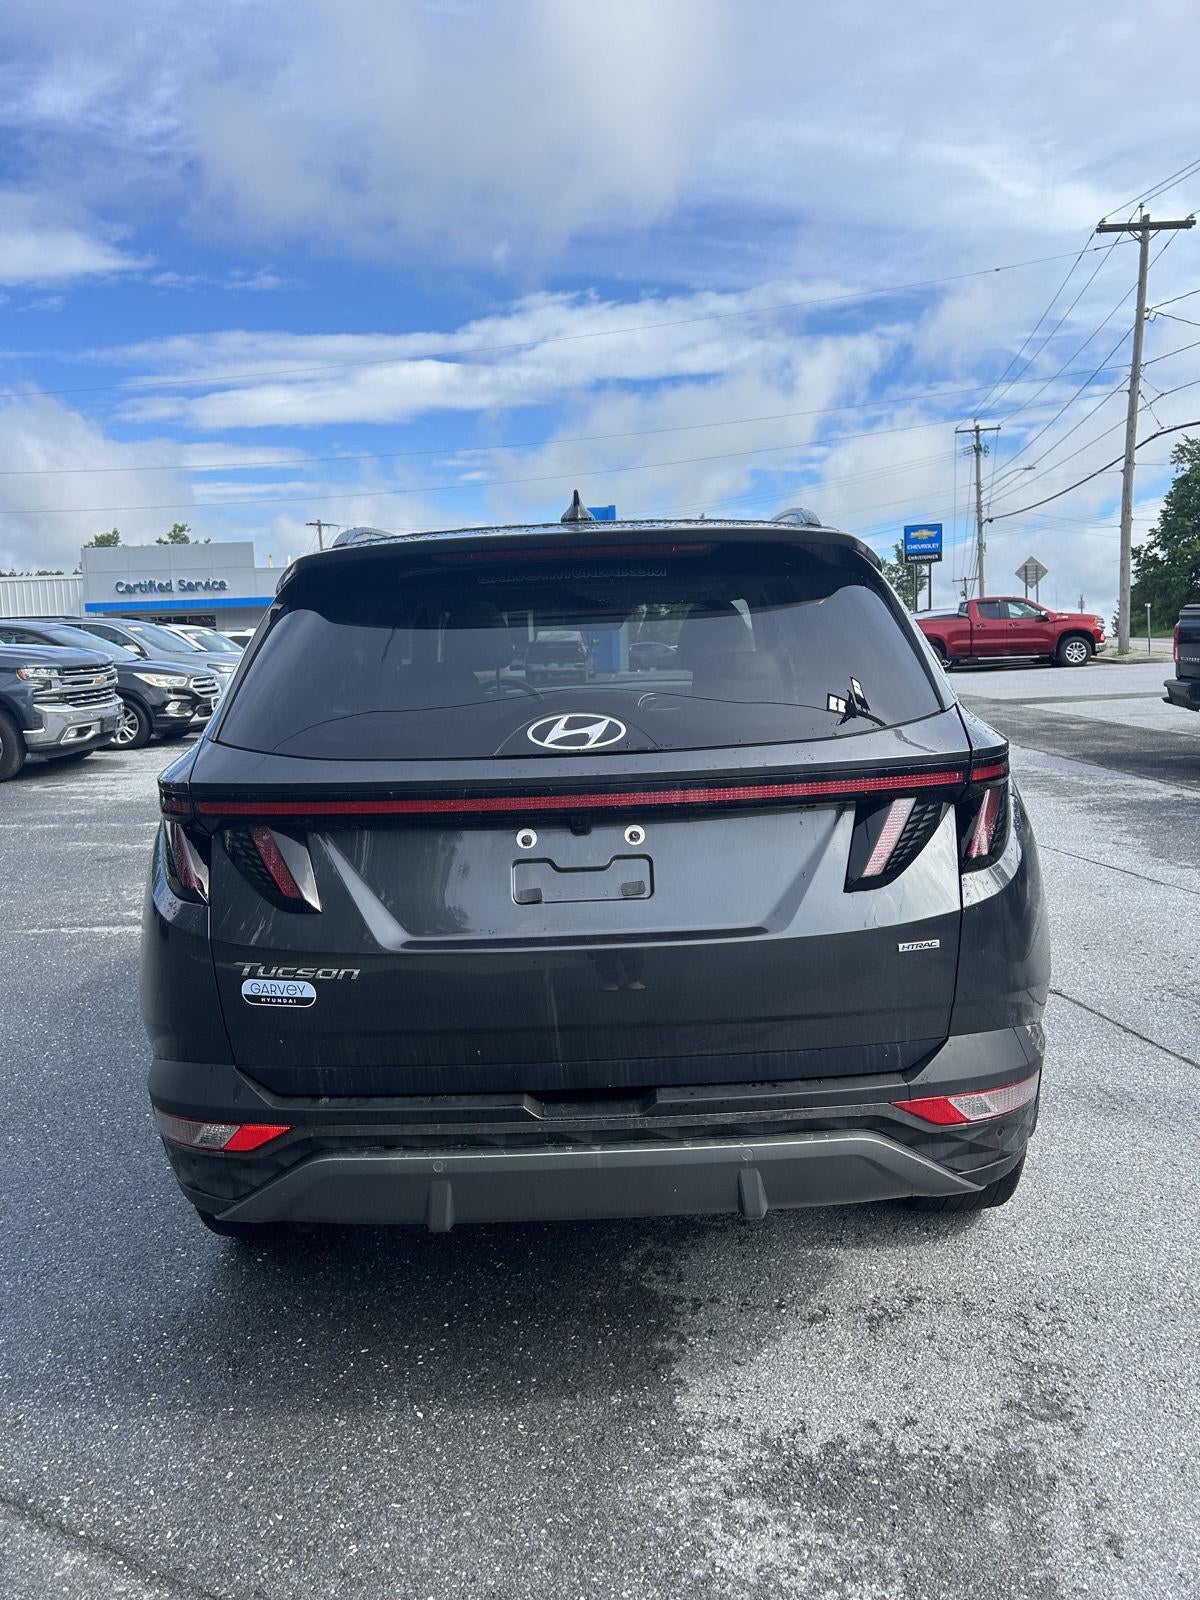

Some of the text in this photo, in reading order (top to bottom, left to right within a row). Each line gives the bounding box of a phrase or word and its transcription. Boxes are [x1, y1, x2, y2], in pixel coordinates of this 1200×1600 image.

[115, 578, 228, 594] Certified Service
[901, 941, 937, 951] HTRAC
